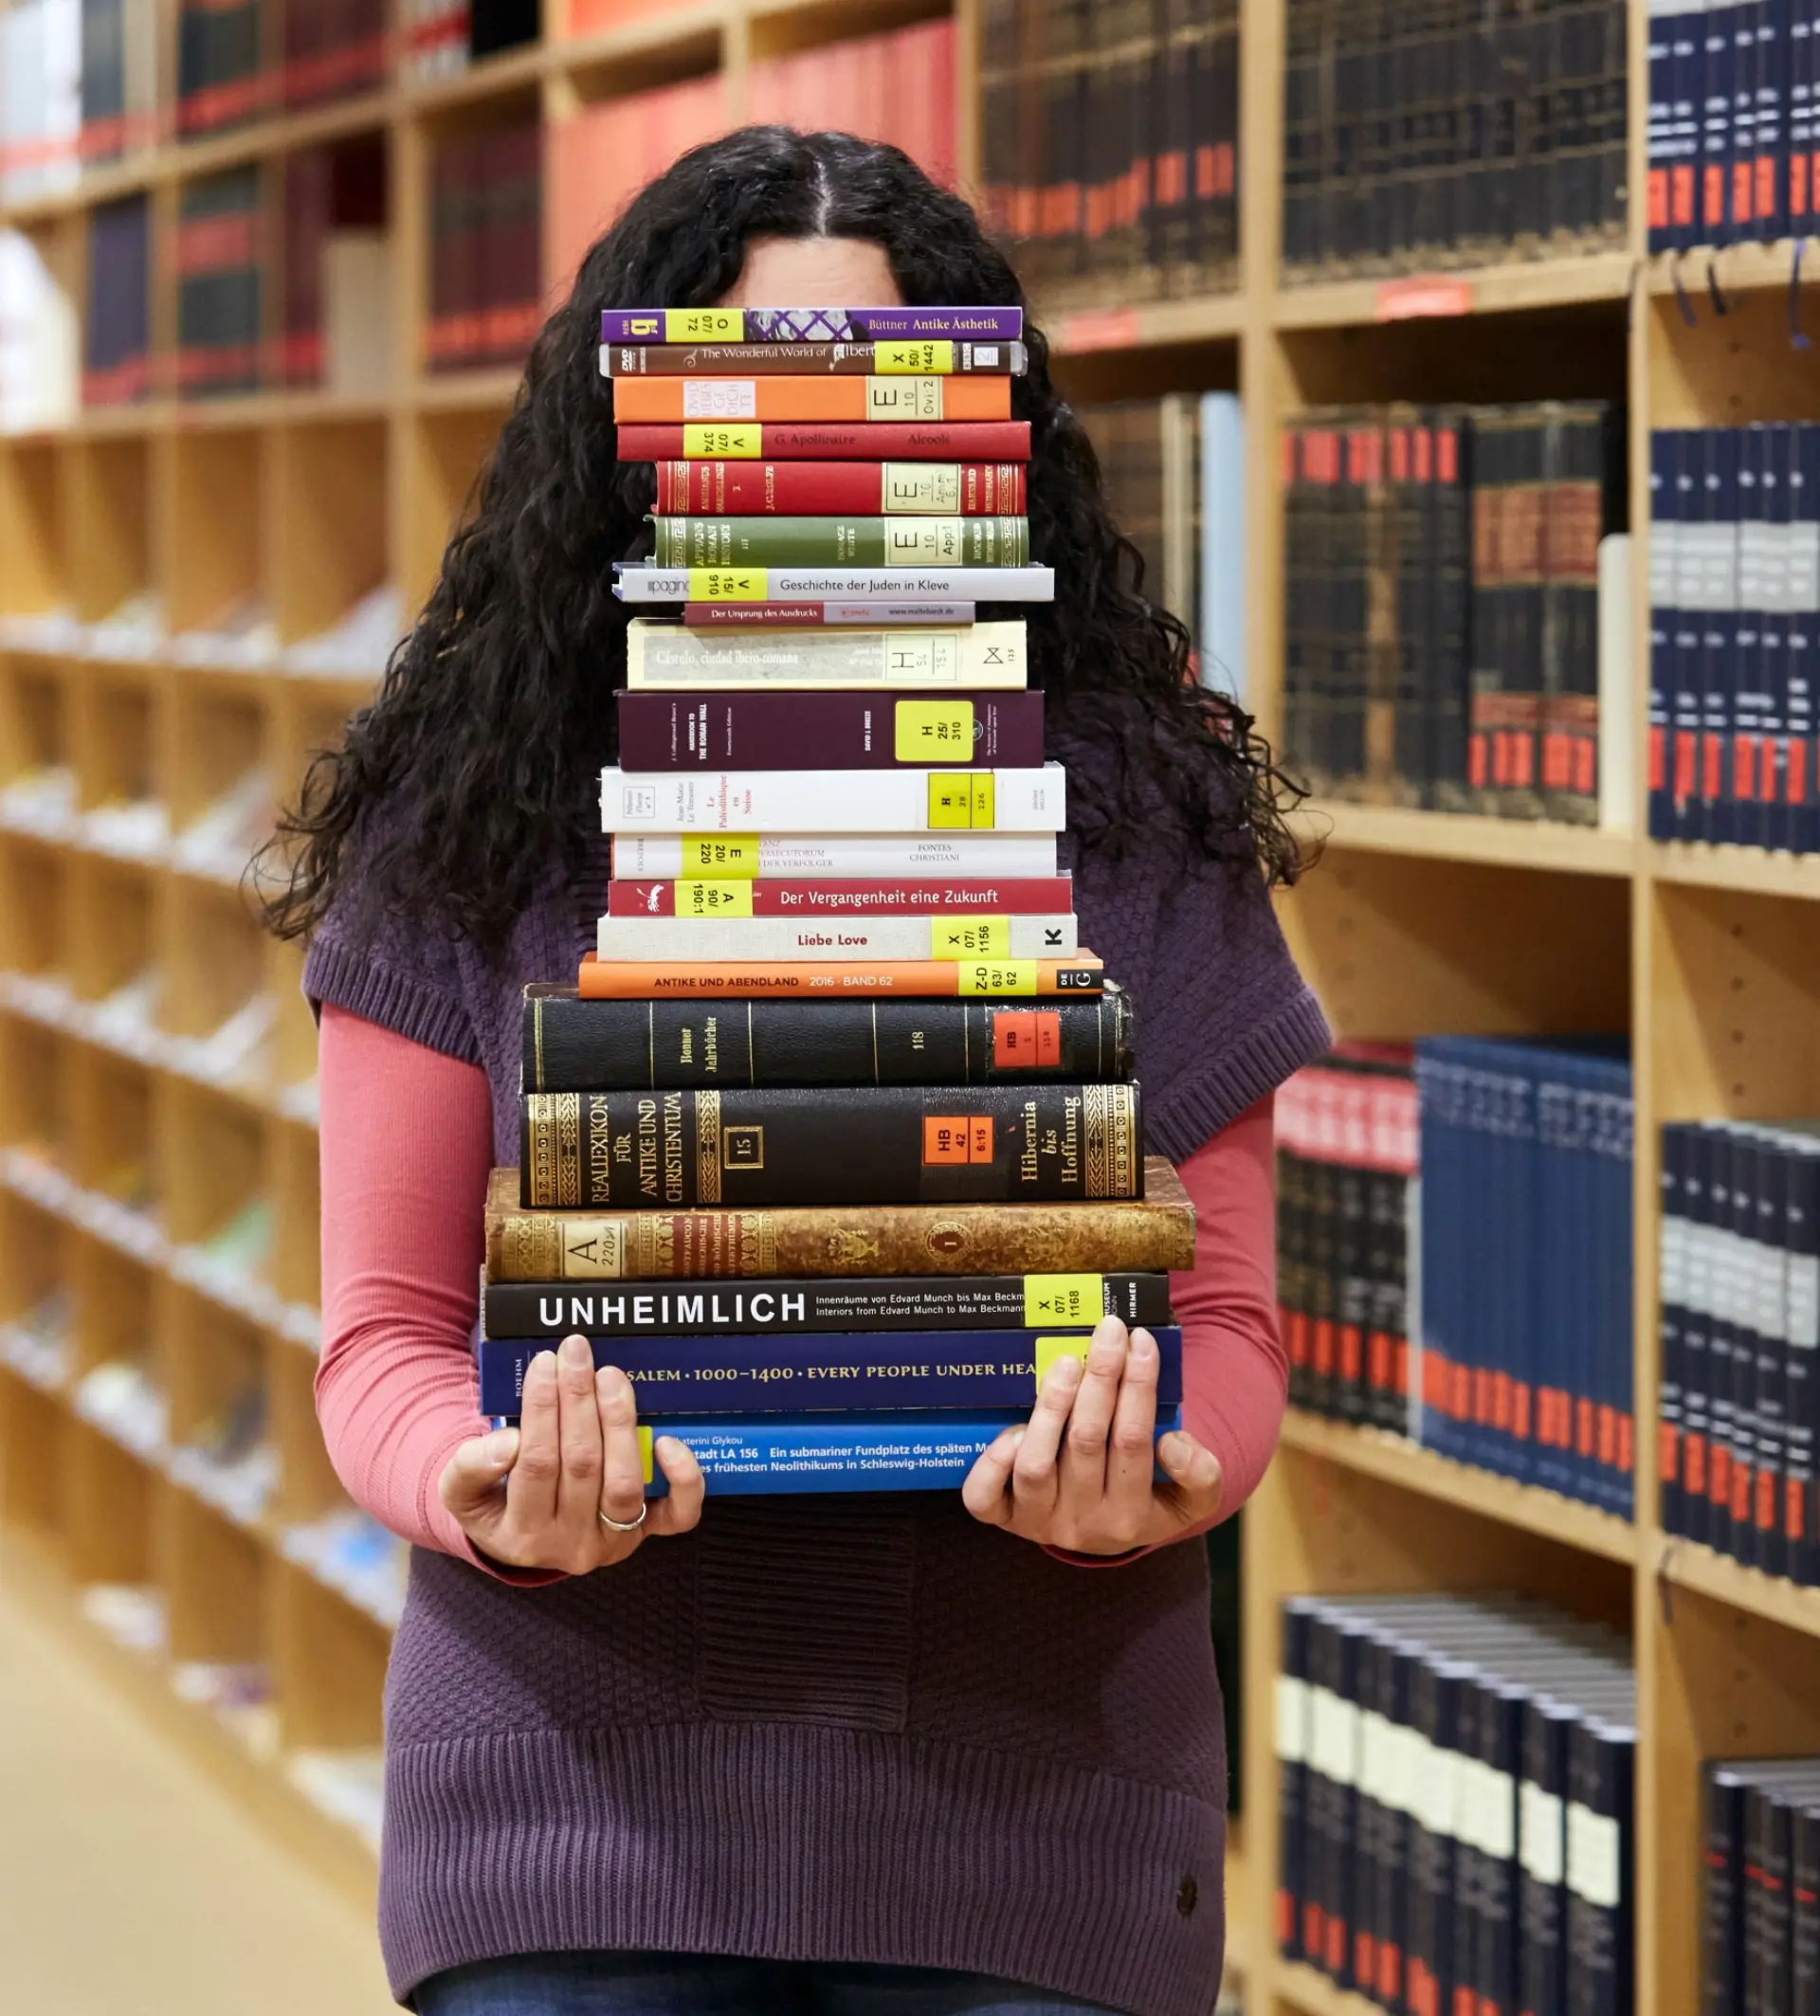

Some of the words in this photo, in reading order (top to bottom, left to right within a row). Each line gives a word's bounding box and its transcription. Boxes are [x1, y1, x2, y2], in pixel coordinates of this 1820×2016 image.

[688, 317, 699, 332] 72
[702, 315, 713, 334] 07/
[718, 318, 729, 329] O
[869, 318, 908, 331] Büttner
[913, 318, 950, 331] Antike
[953, 316, 998, 331] Ästhetik
[702, 348, 720, 359] The
[723, 347, 778, 359] Wonderful
[781, 347, 813, 357] World
[816, 347, 826, 357] of
[893, 353, 904, 363] X
[909, 349, 919, 367] 50/
[923, 343, 934, 372] 1442
[687, 382, 700, 417] OVID
[873, 390, 897, 406] E
[903, 391, 915, 407] 10
[703, 432, 714, 453] 374
[718, 433, 729, 452] 07/
[734, 437, 745, 448] V
[792, 432, 856, 449] Apollinaire
[908, 433, 951, 446] Alcools
[894, 481, 917, 499] E
[920, 481, 931, 497] 10
[895, 532, 918, 548] E
[924, 535, 935, 549] 10
[708, 574, 719, 595] 910
[723, 575, 734, 594] 15/
[738, 579, 749, 590] V
[781, 578, 843, 592] Geschichte
[846, 579, 866, 591] der
[869, 579, 901, 594] Juden
[904, 579, 916, 590] in
[919, 578, 950, 590] Kleve
[711, 608, 725, 619] Der
[728, 608, 763, 622] Ursprung
[766, 608, 778, 618] des
[780, 608, 818, 618] Ausdrucks
[891, 652, 914, 668] H
[921, 725, 934, 736] H
[937, 721, 948, 740] 25/
[952, 721, 961, 740] 310
[706, 796, 716, 808] Le
[941, 797, 952, 807] H
[977, 792, 986, 810] 126
[701, 843, 712, 864] 220
[716, 845, 726, 863] 20/
[730, 848, 742, 858] E
[918, 844, 953, 852] FONTES
[909, 854, 960, 863] CHRISTIANI
[694, 883, 704, 915] 190:1
[708, 889, 719, 908] 90/
[723, 893, 734, 903] A
[780, 891, 805, 904] Der
[808, 889, 907, 908] Vergangenheit
[910, 889, 940, 904] eine
[944, 888, 999, 903] Zukunft
[797, 933, 833, 947] Liebe
[838, 933, 868, 946] Love
[949, 935, 960, 945] X
[965, 931, 975, 950] 07/
[979, 925, 990, 953] 1156
[1045, 928, 1063, 946] K
[654, 976, 697, 989] ANTIKE
[700, 976, 724, 988] UND
[727, 976, 800, 988] ABENDLAND
[810, 975, 834, 987] 2016
[843, 975, 877, 987] BAND
[880, 975, 893, 987] 62
[975, 967, 988, 990] Z-D
[992, 970, 1003, 988] 63/
[1007, 972, 1017, 986] 62
[1060, 973, 1067, 986] DE
[1075, 971, 1091, 988] G
[681, 1027, 692, 1064] Bonner
[704, 1016, 718, 1073] Jahrbücher
[912, 1031, 924, 1050] 118
[1007, 1031, 1017, 1048] HB
[638, 1099, 657, 1135] UND
[590, 1095, 610, 1203] REALLEXIKON
[613, 1132, 632, 1164] FÜR
[664, 1092, 683, 1203] CHRISTENTUM
[737, 1137, 752, 1156] 15
[937, 1129, 951, 1153] HB
[956, 1132, 967, 1148] 42
[976, 1128, 987, 1153] 6:15
[1021, 1100, 1039, 1183] Hibernia
[1042, 1128, 1058, 1155] bis
[1061, 1096, 1082, 1185] Hoffnung
[640, 1136, 659, 1197] ANTIKE
[568, 1238, 597, 1264] A
[815, 1295, 868, 1306] Innenräume
[871, 1297, 886, 1305] von
[889, 1295, 920, 1305] Edvard
[923, 1294, 953, 1304] Munch
[956, 1293, 970, 1303] bis
[973, 1293, 992, 1303] Max
[994, 1292, 1024, 1303] Beckm
[1039, 1299, 1050, 1311] X
[1055, 1295, 1065, 1315] 07/
[1069, 1290, 1080, 1318] 1168
[1129, 1281, 1138, 1318] HIRMER
[538, 1292, 805, 1326] UNHEIMLICH
[816, 1307, 853, 1317] Interiors
[856, 1307, 876, 1317] from
[880, 1306, 912, 1317] Edvard
[915, 1305, 944, 1316] Munch
[947, 1306, 956, 1316] to
[959, 1304, 977, 1315] Max
[980, 1303, 1026, 1316] Beckmann
[627, 1370, 681, 1381] SALEM
[807, 1366, 858, 1379] EVERY
[866, 1365, 931, 1378] PEOPLE
[936, 1364, 995, 1377] UNDER
[1002, 1363, 1036, 1375] HEA
[695, 1448, 717, 1460] tadt
[720, 1448, 736, 1459] LA
[739, 1447, 758, 1459] 156
[770, 1447, 788, 1459] Ein
[790, 1445, 852, 1459] submariner
[855, 1444, 910, 1457] Fundplatz
[913, 1444, 932, 1455] des
[934, 1442, 973, 1457] späten
[712, 1436, 743, 1448] Glykou
[715, 1461, 768, 1474] frühesten
[771, 1460, 844, 1472] Neolithikums
[846, 1459, 857, 1470] in
[859, 1457, 965, 1472] Schleswig-Holstein
